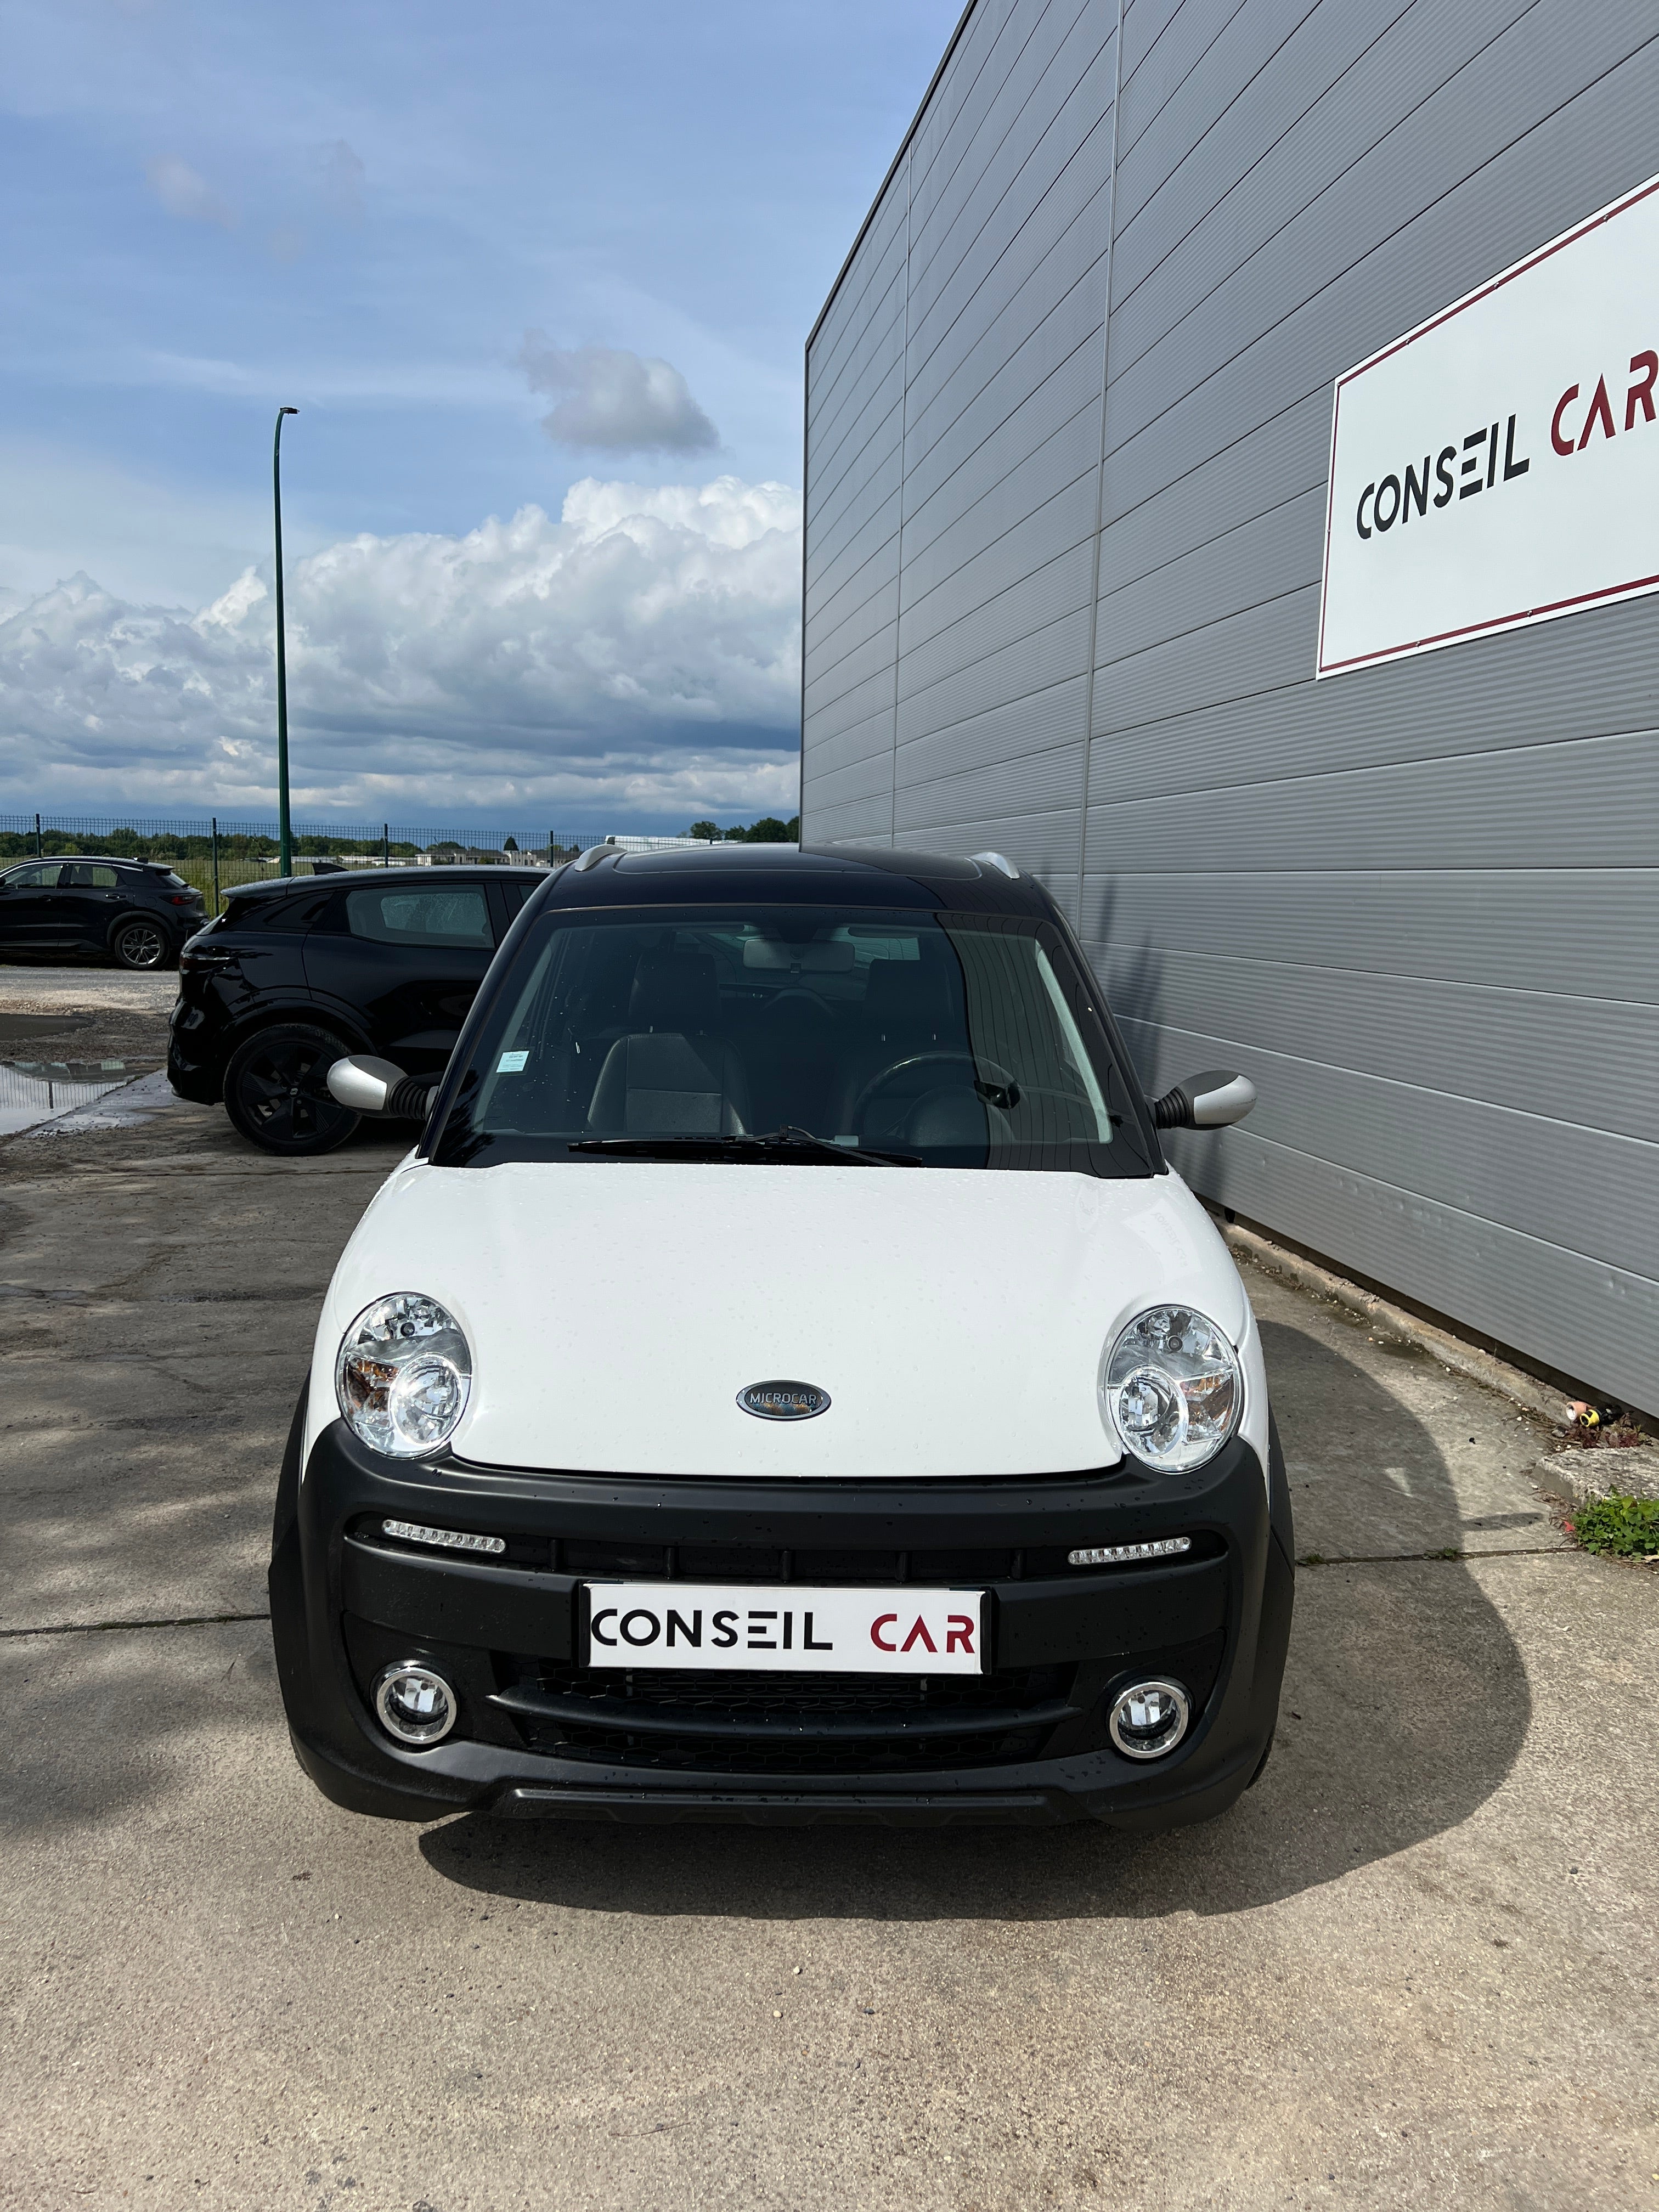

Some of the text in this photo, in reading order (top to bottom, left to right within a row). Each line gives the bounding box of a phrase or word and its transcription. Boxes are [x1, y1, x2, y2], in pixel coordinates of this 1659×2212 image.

[1357, 349, 1658, 539] CONSEIL CAR
[749, 1392, 817, 1404] MICROCAR
[591, 1608, 975, 1653] CONSEIL CAR
